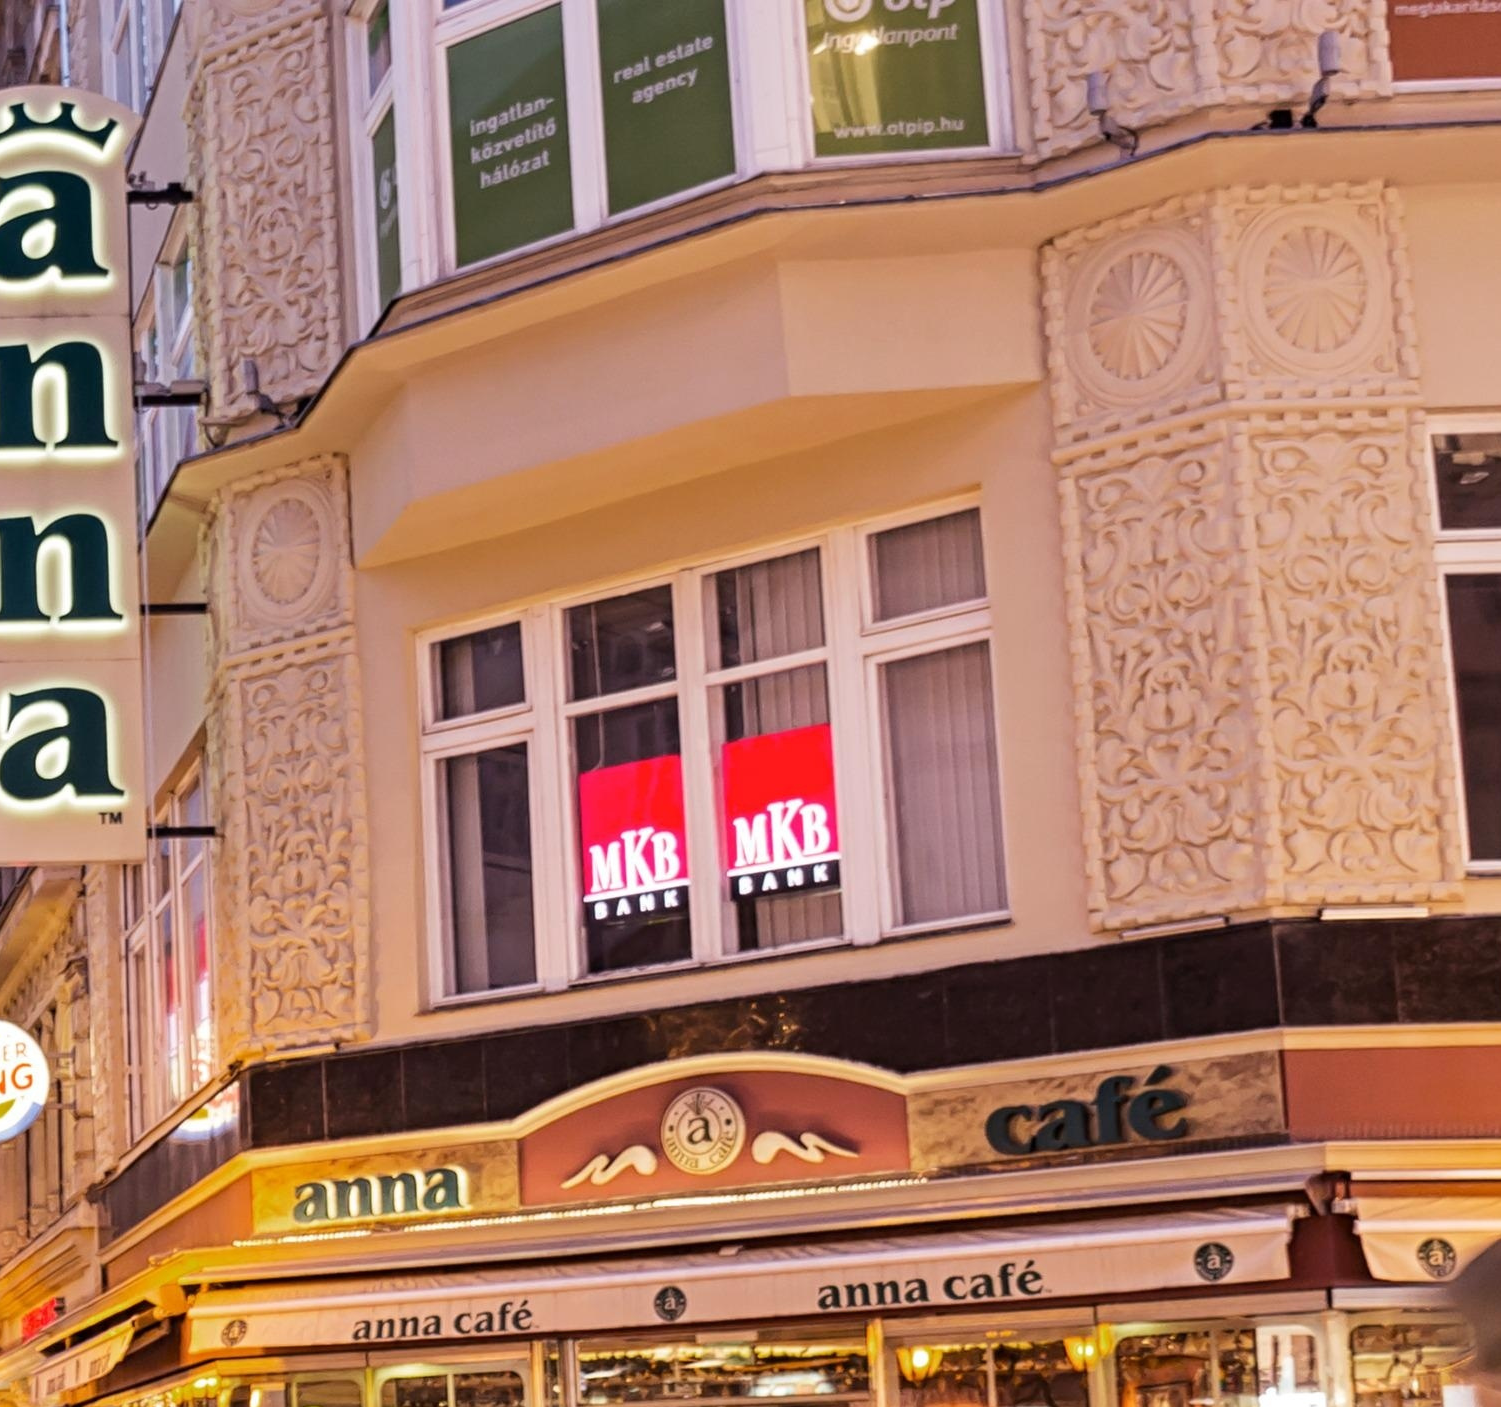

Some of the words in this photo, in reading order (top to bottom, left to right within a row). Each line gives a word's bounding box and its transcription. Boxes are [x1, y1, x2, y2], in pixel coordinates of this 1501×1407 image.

[822, 23, 958, 54] ingtlanpont
[613, 56, 651, 84] real
[655, 36, 713, 68] estate
[632, 68, 698, 103] agency
[470, 98, 555, 137] ingatlan-
[480, 149, 551, 190] hálózat
[732, 797, 831, 869] MKB
[589, 826, 681, 893] MKB
[737, 862, 830, 896] BANK
[593, 890, 680, 921] BANK
[985, 1064, 1189, 1155] café
[293, 1167, 465, 1223] anna
[817, 1277, 930, 1310] anna
[942, 1259, 1044, 1301] café
[352, 1314, 442, 1341] anna
[453, 1299, 534, 1335] café
